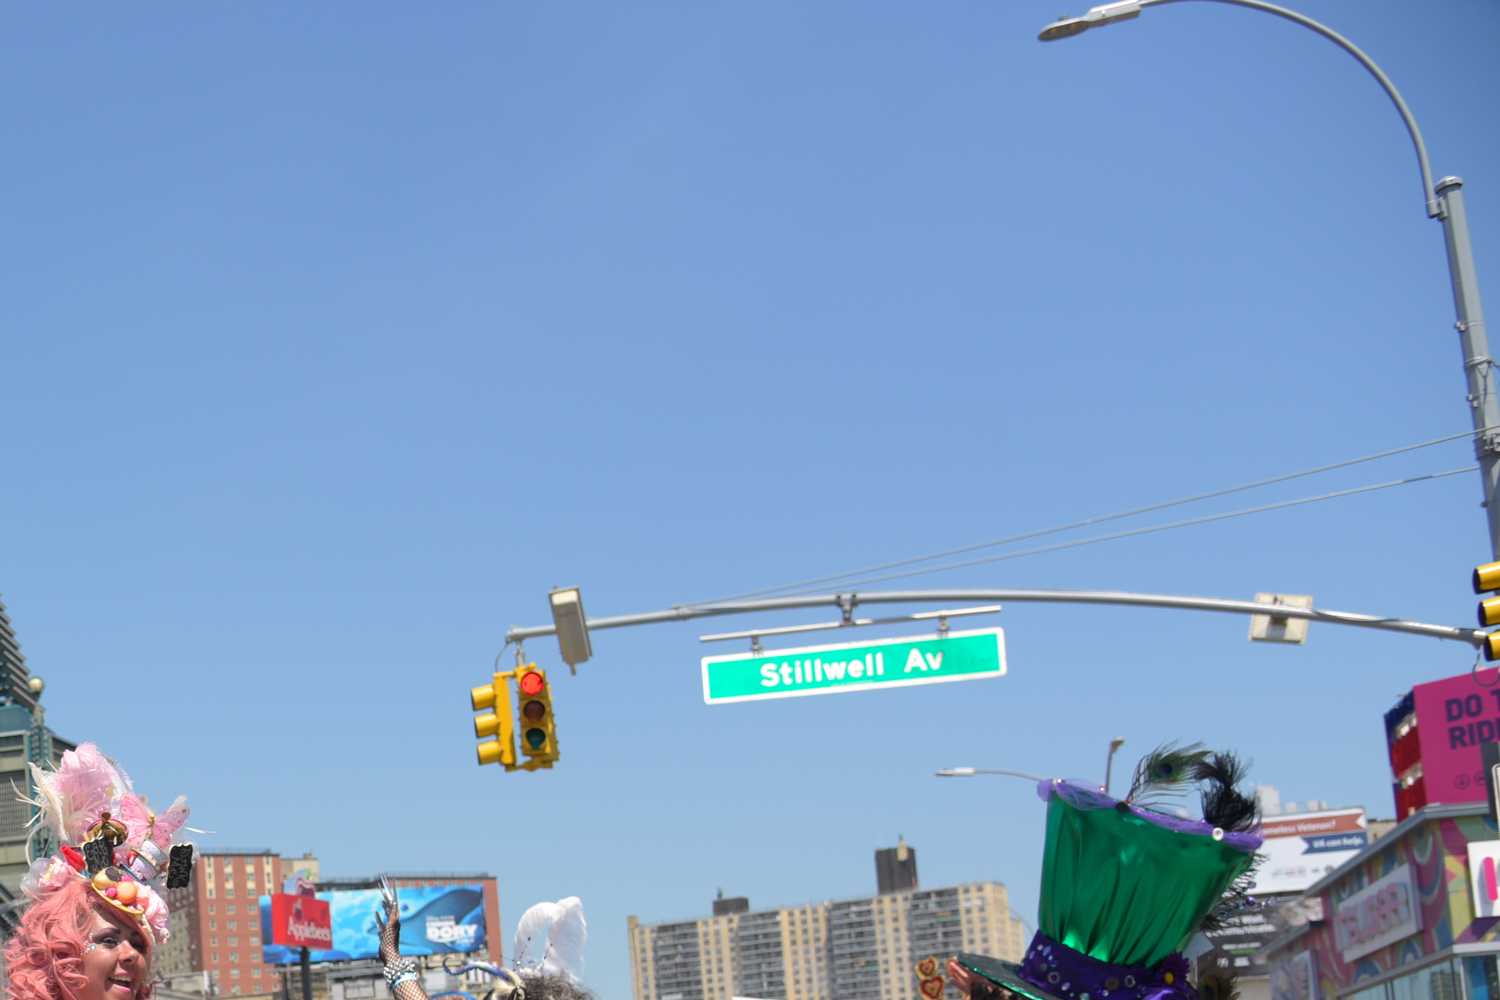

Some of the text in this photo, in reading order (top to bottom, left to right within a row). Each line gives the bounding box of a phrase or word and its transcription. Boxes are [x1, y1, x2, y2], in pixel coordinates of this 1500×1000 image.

[760, 648, 945, 687] Stillwell Av
[1445, 694, 1483, 722] DO
[1297, 819, 1336, 832] Veteran?
[426, 923, 478, 940] DORY
